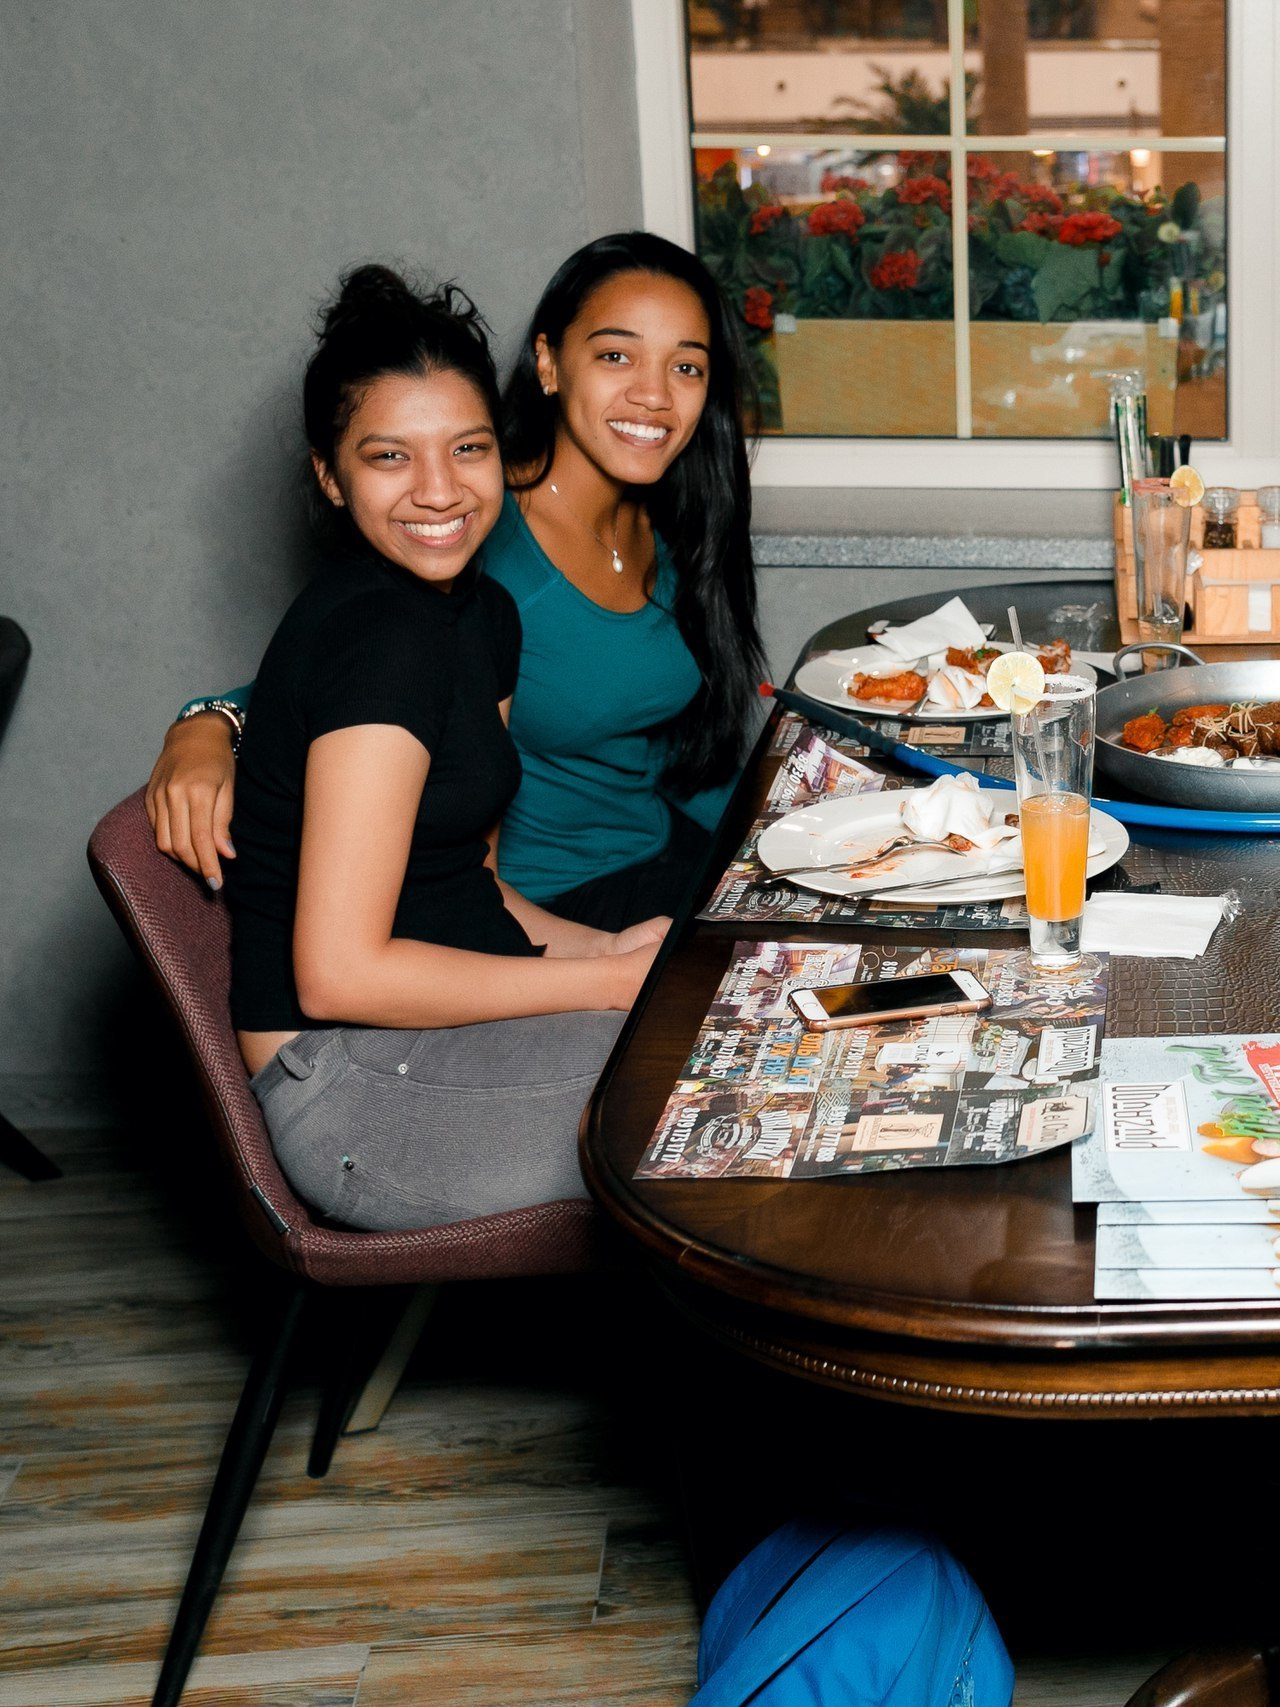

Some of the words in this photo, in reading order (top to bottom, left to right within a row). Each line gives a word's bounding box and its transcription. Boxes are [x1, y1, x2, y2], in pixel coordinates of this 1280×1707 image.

[763, 1032, 796, 1075] КУХНЯ
[786, 1032, 824, 1085] ОЛЬШАЯ
[912, 1043, 930, 1061] UTKA
[1042, 1113, 1070, 1122] el
[1040, 1123, 1068, 1141] Chico
